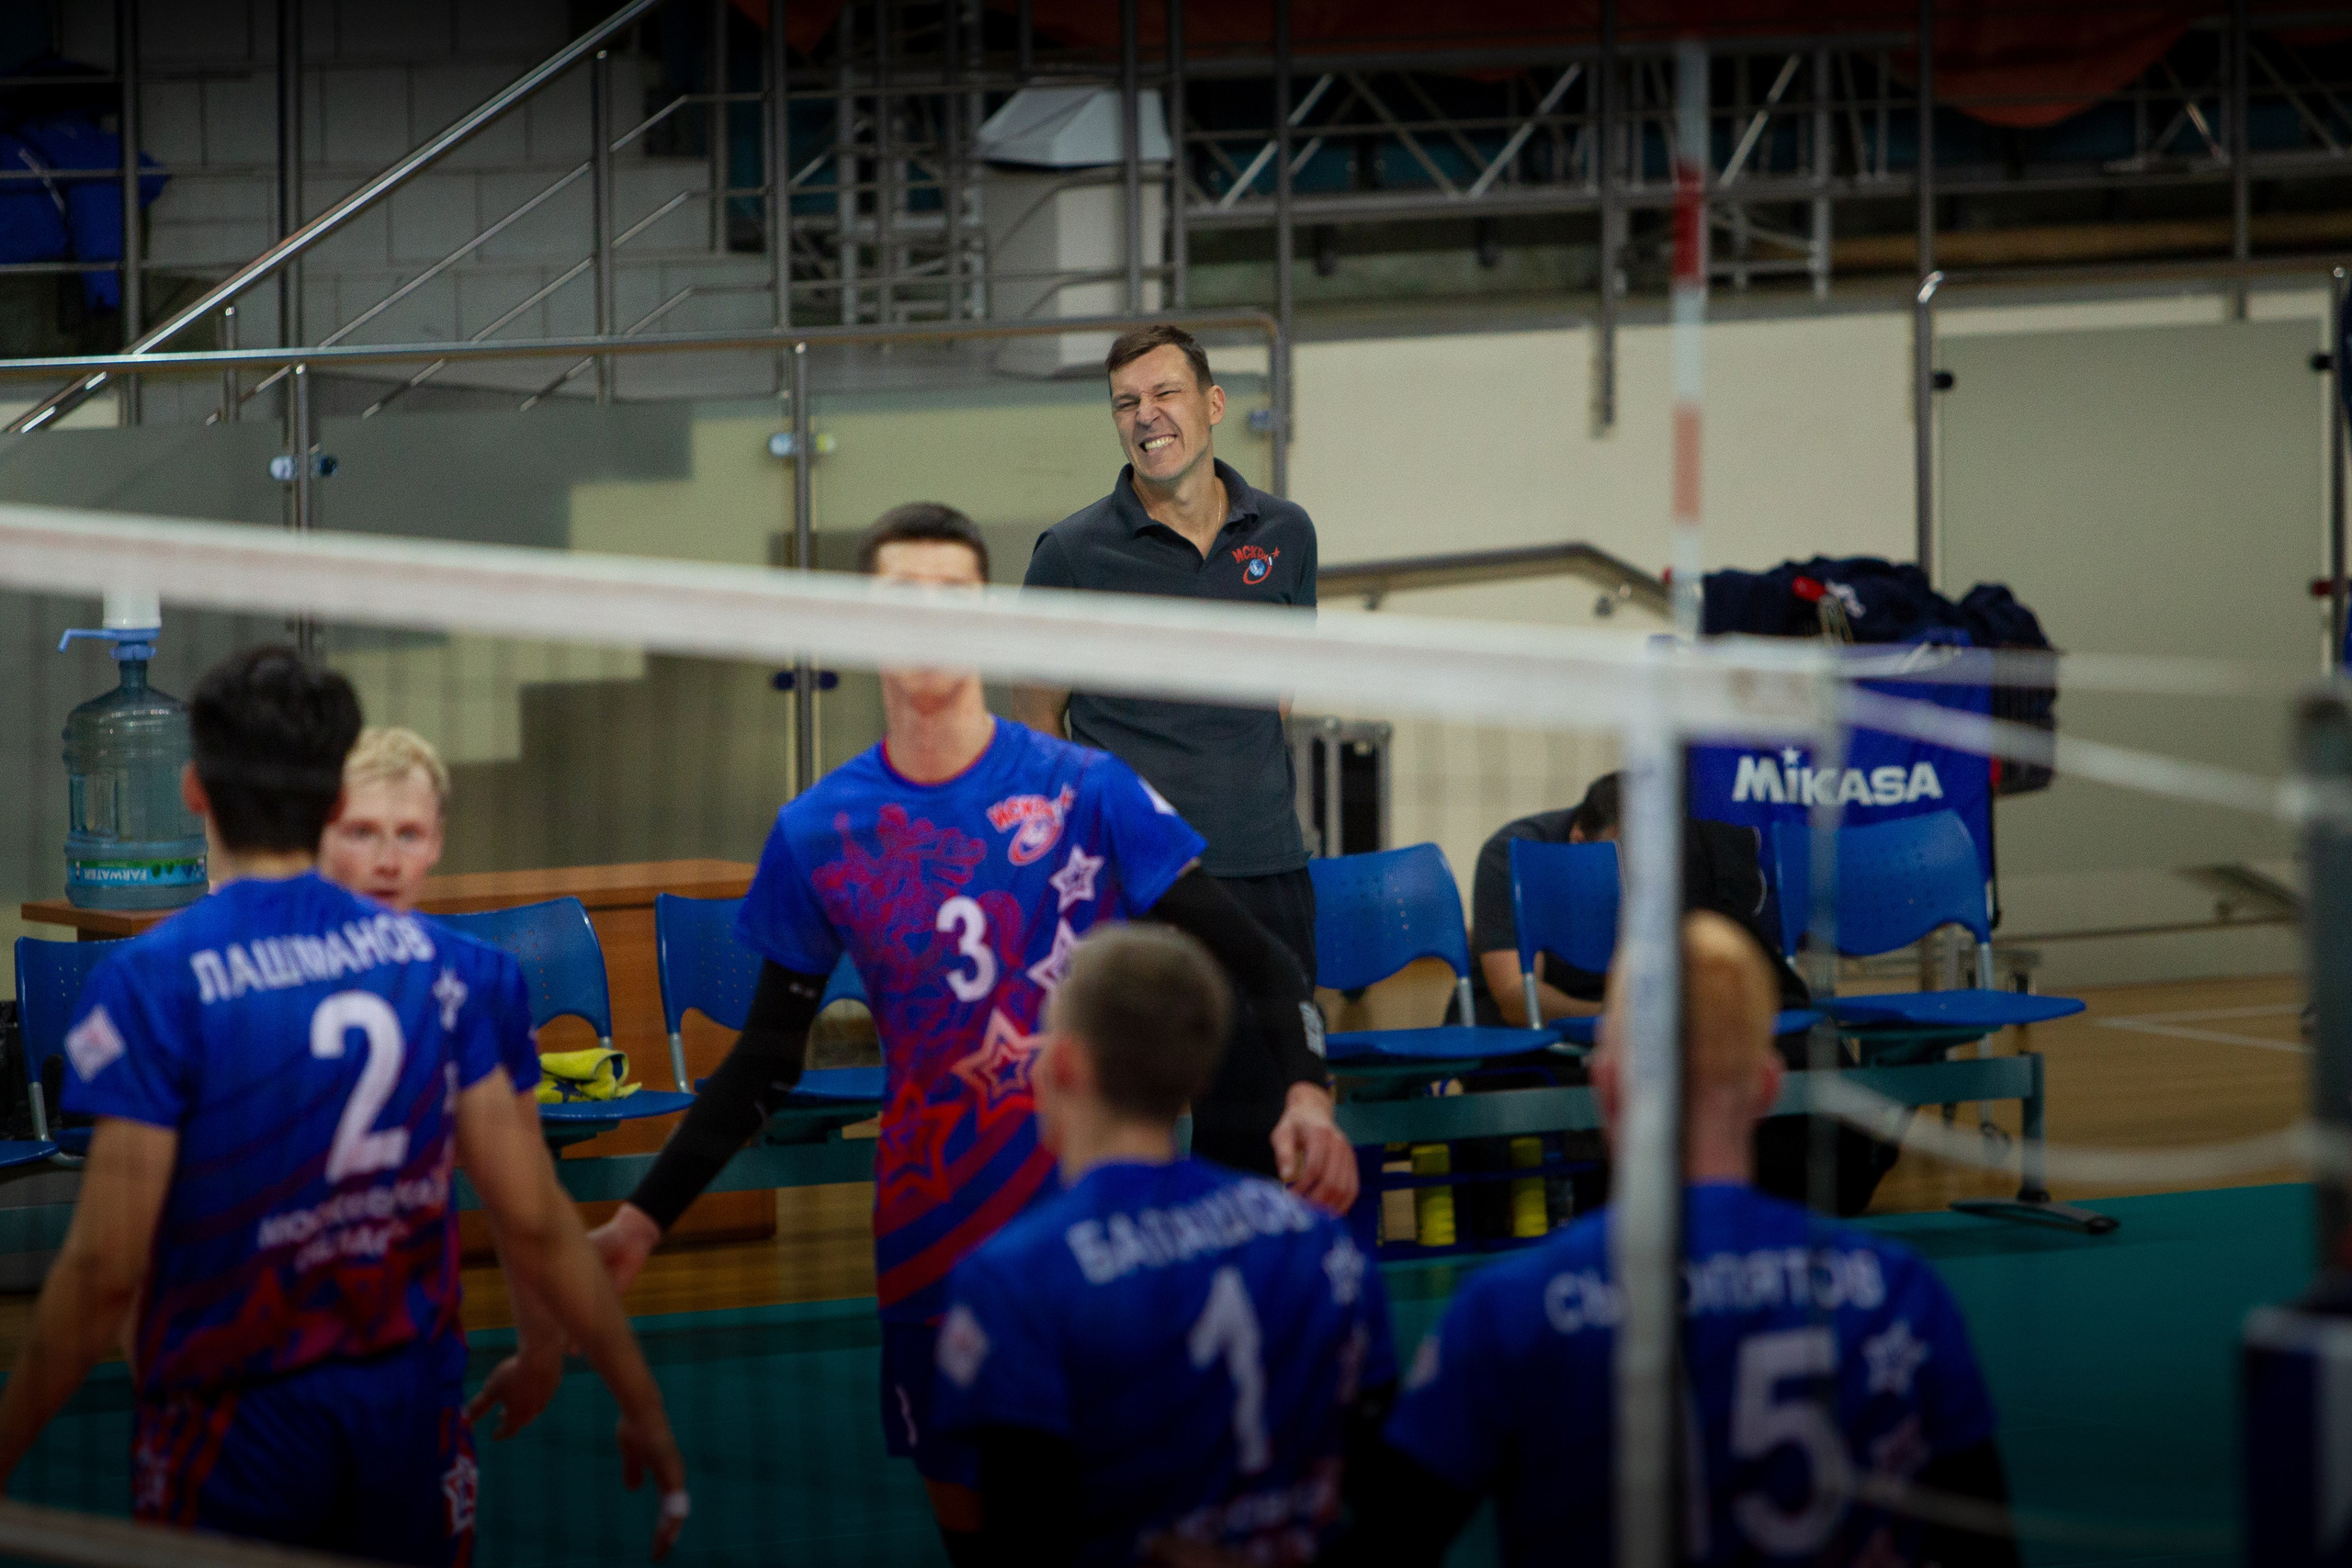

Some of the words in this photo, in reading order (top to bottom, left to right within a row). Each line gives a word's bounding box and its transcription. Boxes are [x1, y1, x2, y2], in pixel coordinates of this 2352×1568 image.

[85, 868, 147, 882] FARWATER
[936, 895, 997, 1002] 3
[310, 989, 412, 1184] 2
[1188, 1264, 1271, 1474] 1
[1730, 1325, 1854, 1557] 5
